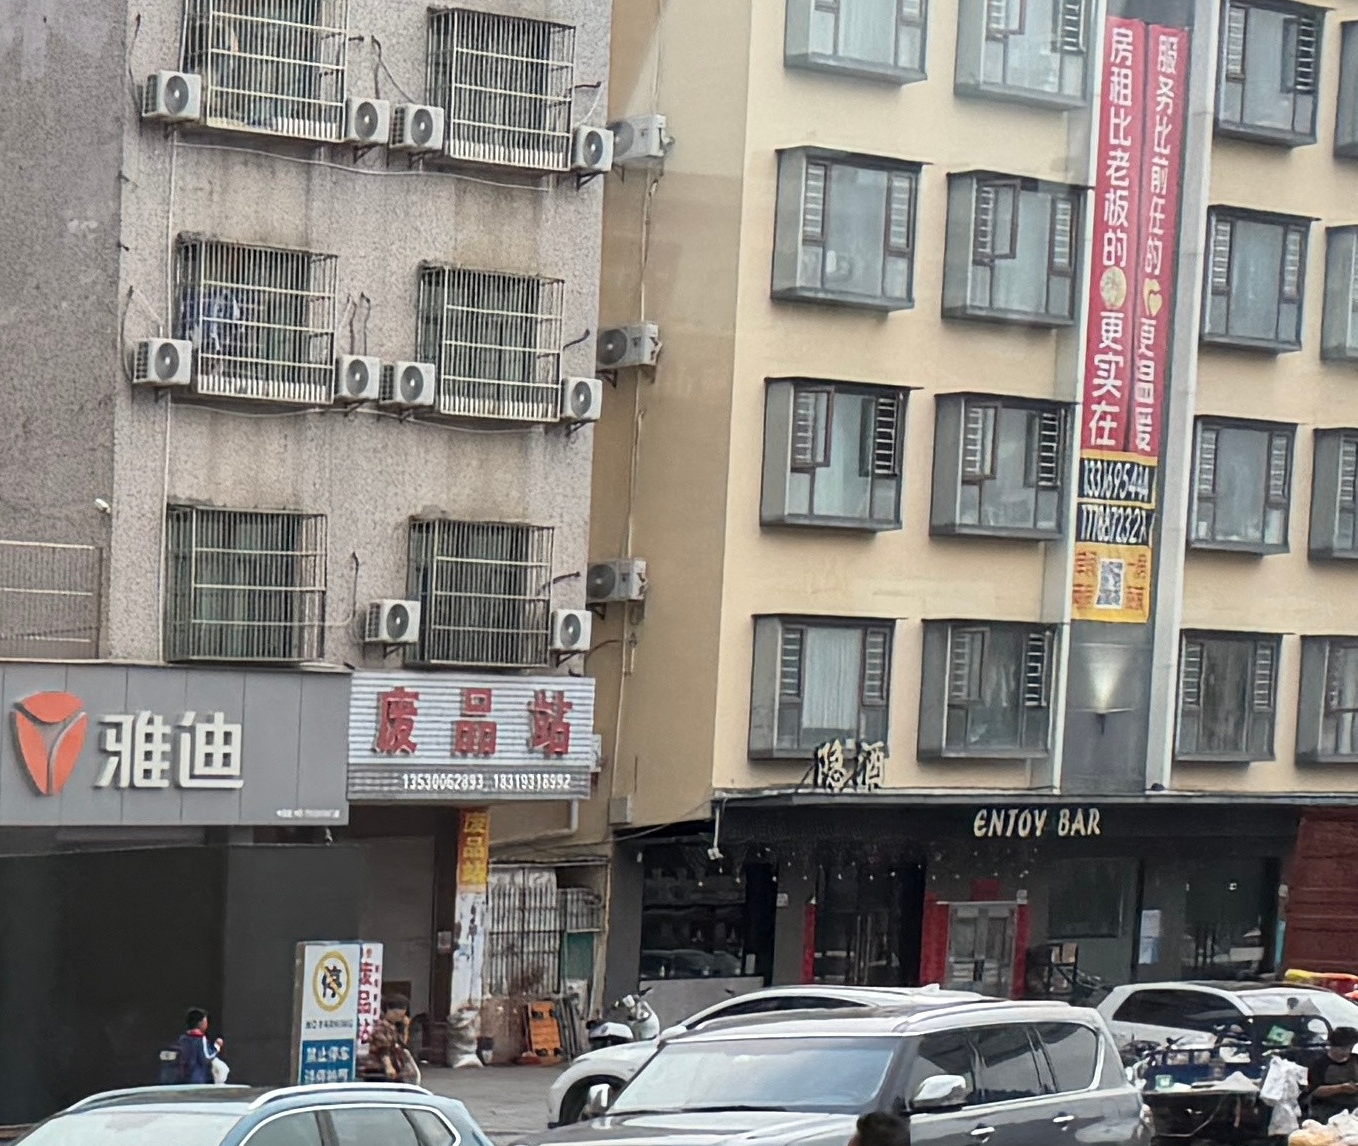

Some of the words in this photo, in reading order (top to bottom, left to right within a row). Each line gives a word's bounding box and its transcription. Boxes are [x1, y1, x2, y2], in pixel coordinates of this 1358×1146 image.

[1102, 27, 1133, 268] 房租比老板的
[1145, 35, 1179, 276] 服务比前任的
[1089, 311, 1125, 448] 更实在
[94, 709, 244, 790] 雅迪
[373, 686, 574, 758] 废品站
[1057, 806, 1102, 838] BAR
